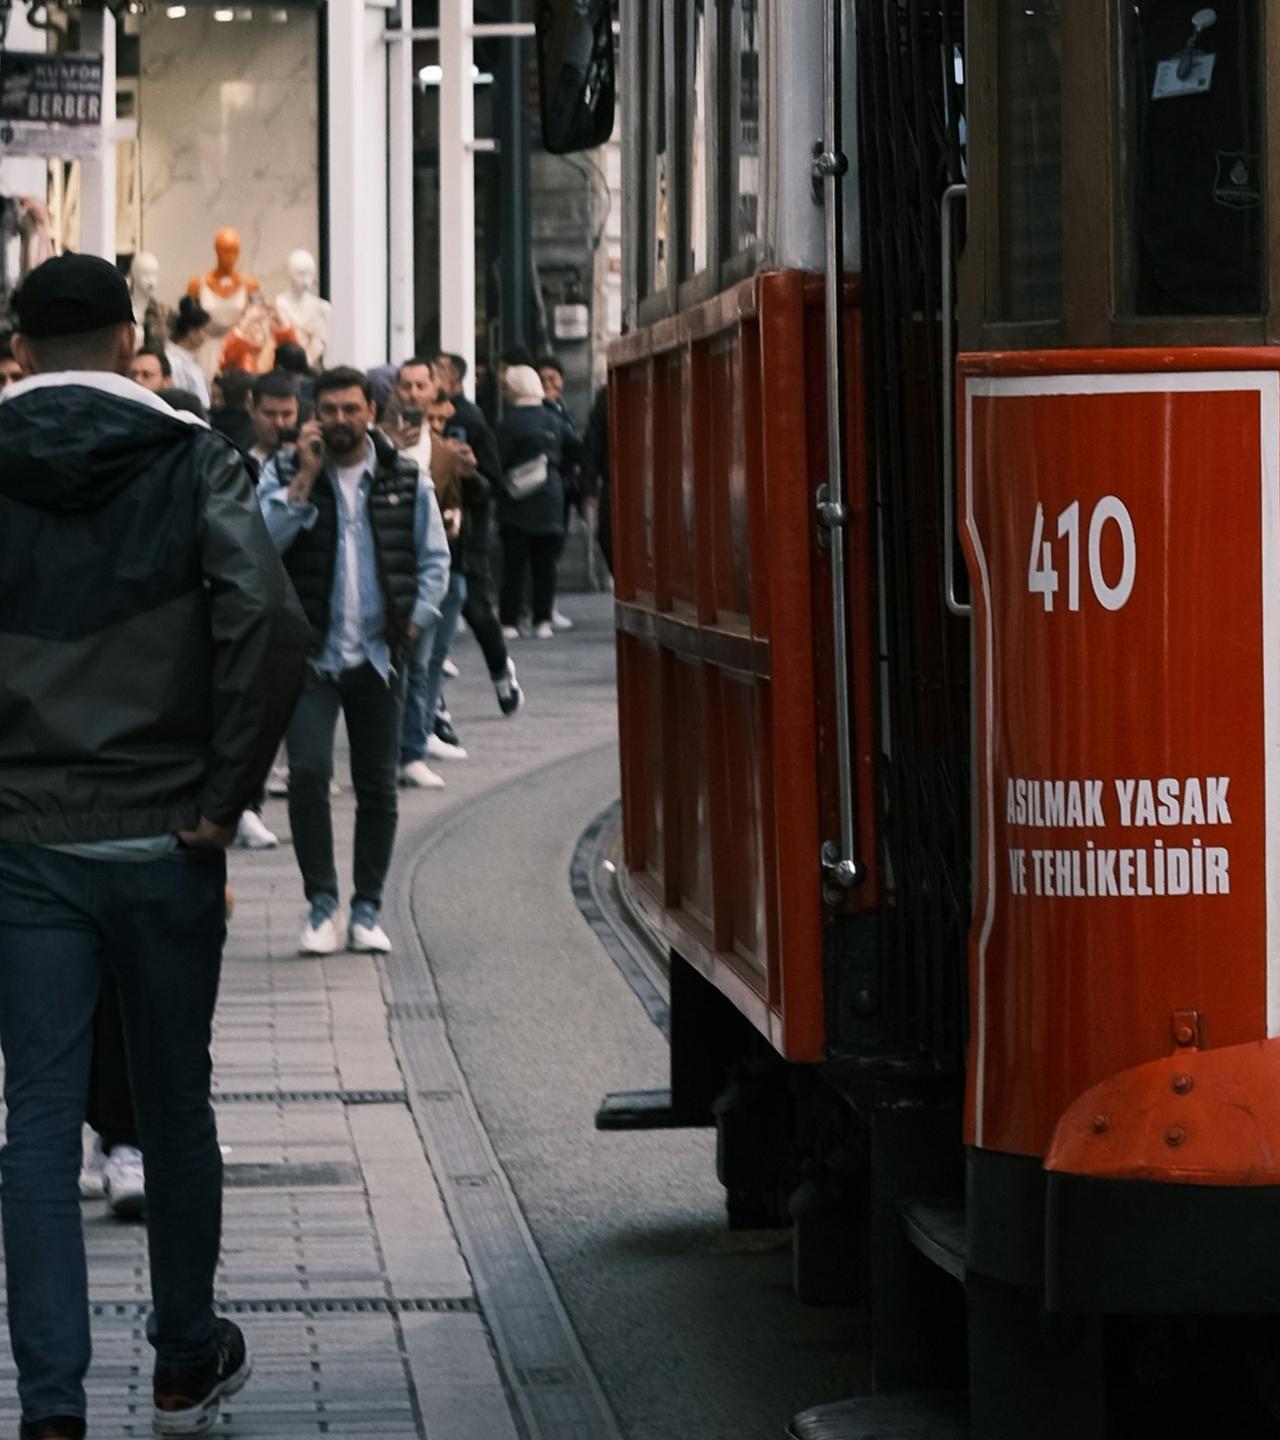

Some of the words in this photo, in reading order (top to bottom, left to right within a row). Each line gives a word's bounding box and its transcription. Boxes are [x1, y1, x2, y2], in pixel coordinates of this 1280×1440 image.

[27, 91, 101, 119] BERBER
[1027, 495, 1137, 612] 410
[1006, 777, 1106, 828] ASILMAK
[1114, 776, 1232, 827] YASAK
[1008, 847, 1028, 896] VE
[1031, 837, 1231, 897] TEHLİKELİDİR
